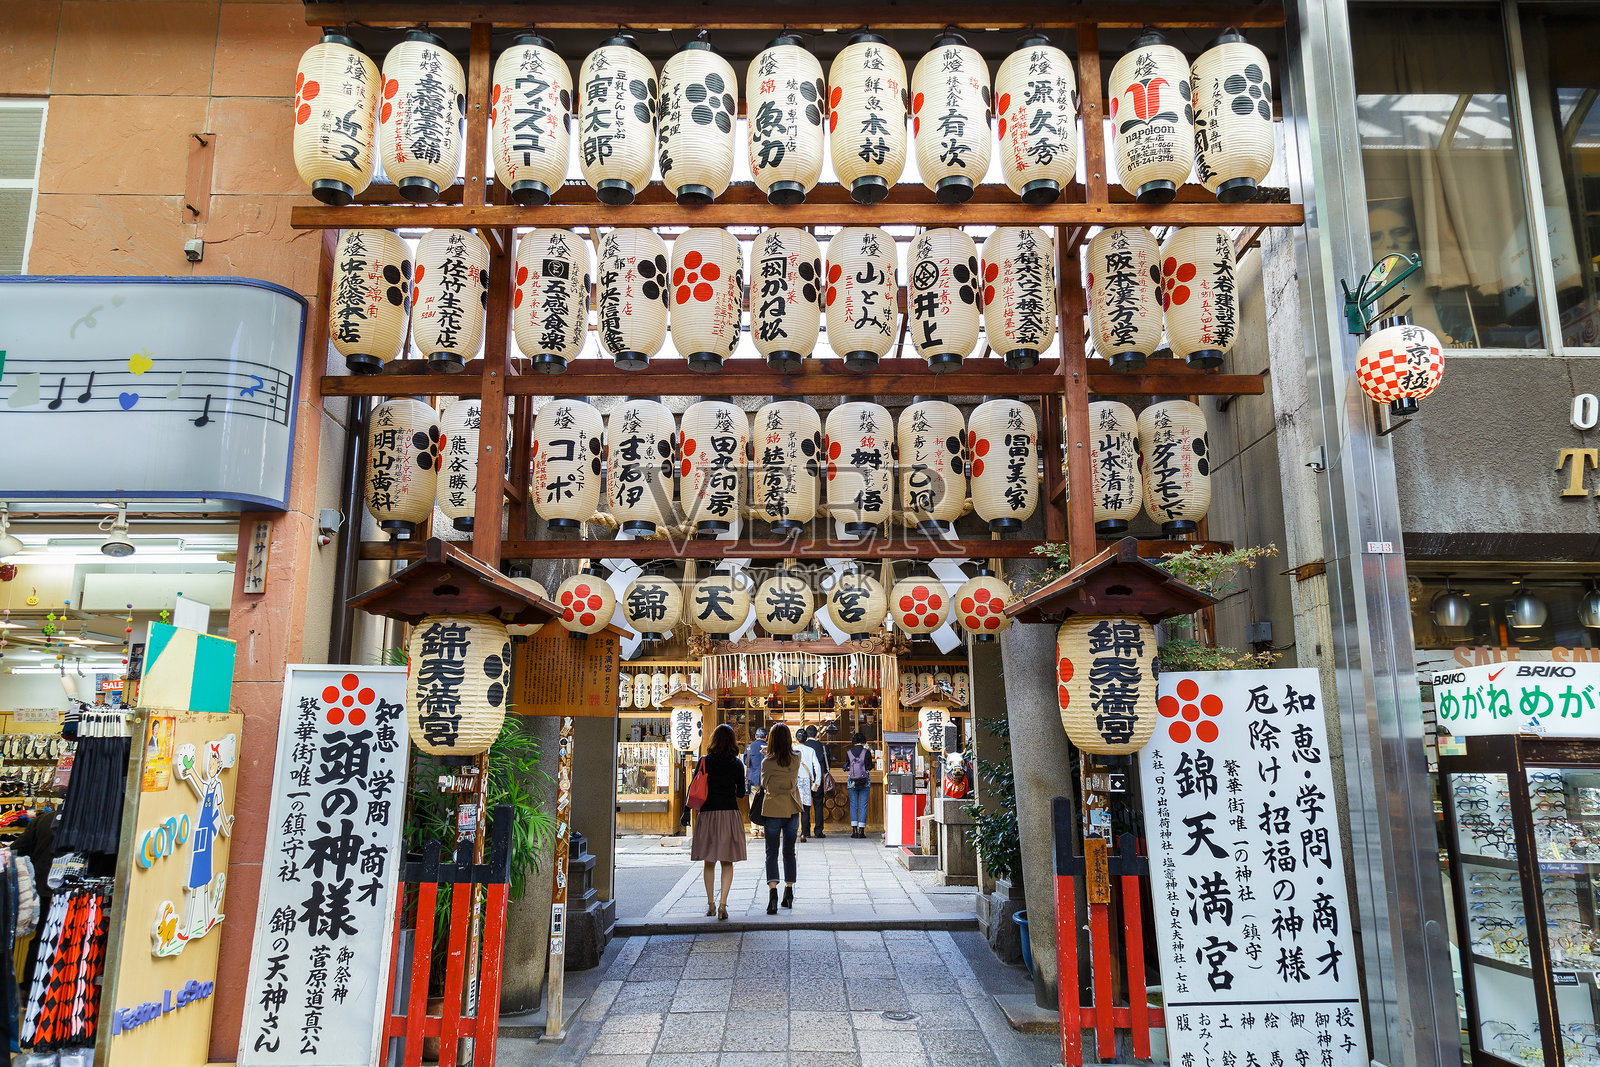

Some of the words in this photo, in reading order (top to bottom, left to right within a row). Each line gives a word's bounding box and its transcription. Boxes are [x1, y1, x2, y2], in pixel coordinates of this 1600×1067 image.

[512, 74, 550, 167] ウィズユー
[584, 73, 615, 168] 寅太郎
[864, 76, 885, 112] 鮮魚
[1023, 79, 1061, 166] 源久秀
[332, 109, 364, 173] 近又
[753, 100, 789, 170] 魚力
[858, 112, 892, 166] 木村
[936, 108, 973, 168] 有次
[436, 258, 470, 348] 佐竹生花店
[786, 252, 800, 305] 京野菜
[1013, 252, 1045, 345] 積水ハウス株式会社
[1105, 251, 1141, 347] 阪本漢方堂
[1212, 260, 1236, 347] 大岩建設工業
[538, 279, 571, 353] 五感食楽
[913, 291, 944, 350] 井上
[1400, 326, 1430, 391] 新京極
[370, 428, 399, 513] 明山歯科
[546, 439, 576, 504] コポ
[706, 436, 738, 517] 田丸印房
[1099, 433, 1126, 512] 山本清掃
[251, 541, 266, 588] サノヤ
[1369, 543, 1392, 553] E-13
[627, 584, 669, 623] 錦
[695, 584, 735, 622] 天
[832, 583, 871, 624] 宮
[102, 681, 124, 690] SALE
[416, 621, 472, 748] 錦天満宮
[604, 638, 614, 673] 錦天満宮
[1087, 620, 1146, 745] 錦天満宮
[1433, 672, 1466, 687] BRIKO
[1516, 665, 1577, 678] BRIKO
[676, 710, 694, 750] 錦天満宮
[1439, 683, 1513, 722] めがね
[1519, 684, 1600, 720] めが
[277, 696, 321, 883] 繁華街唯一の鎮守社
[355, 697, 405, 907] 知恵・学問・商才
[140, 813, 190, 869] COPO
[297, 728, 374, 941] 頭の神様
[1223, 759, 1257, 902] 繁華街唯一の神社
[1245, 684, 1311, 984] 厄除け・招福の神様
[1283, 684, 1343, 983] 知恵・学問・商才
[1172, 748, 1239, 993] 錦天満宮
[253, 904, 298, 1054] 錦の天神さん
[300, 944, 332, 1055] 菅原道真公
[332, 945, 355, 1006] 御祭神
[1176, 1014, 1196, 1067] 腹帯
[1198, 1014, 1216, 1067] おみくじ
[1218, 1013, 1237, 1067] 土鈴
[1240, 1012, 1262, 1067] 神矢
[1264, 1012, 1284, 1067] 絵馬
[1289, 1011, 1311, 1067] 御守
[1314, 1011, 1335, 1067] 御神符
[1335, 1007, 1358, 1054] 授与
